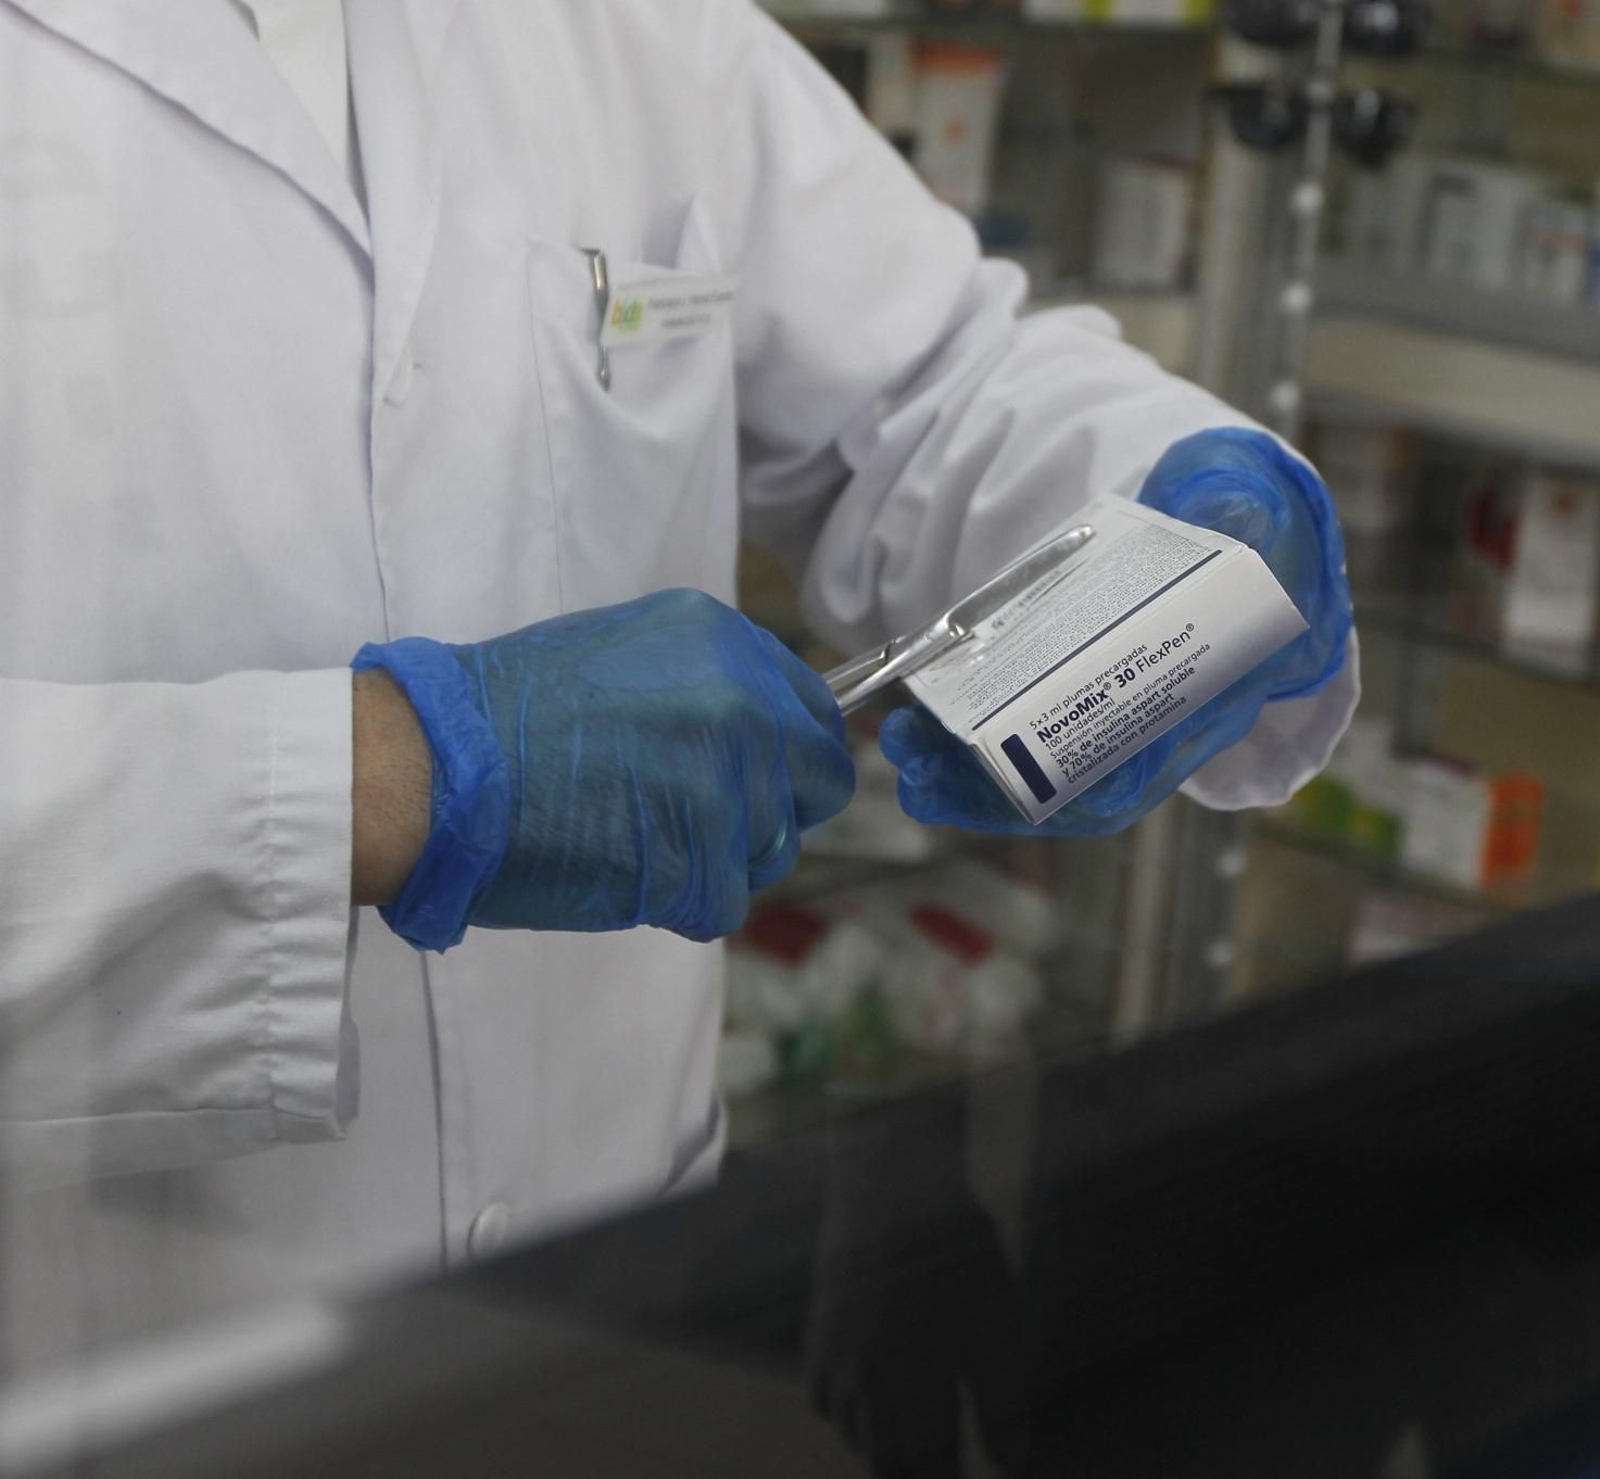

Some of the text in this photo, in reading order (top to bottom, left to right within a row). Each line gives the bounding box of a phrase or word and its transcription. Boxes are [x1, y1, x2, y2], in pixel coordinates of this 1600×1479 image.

[1048, 702, 1062, 716] ml
[1061, 681, 1094, 708] plumas
[1094, 643, 1147, 685] precargadas
[1049, 643, 1210, 759] Suspensión inyectable en pluma precargada
[1055, 666, 1195, 768] 30% de insulina aspart soluble
[1113, 667, 1136, 688] 30
[1044, 696, 1115, 750] 100 unidades/ml
[1061, 692, 1174, 777] y 70% de insulina aspart
[1067, 696, 1186, 783] cristalizada con protamina
